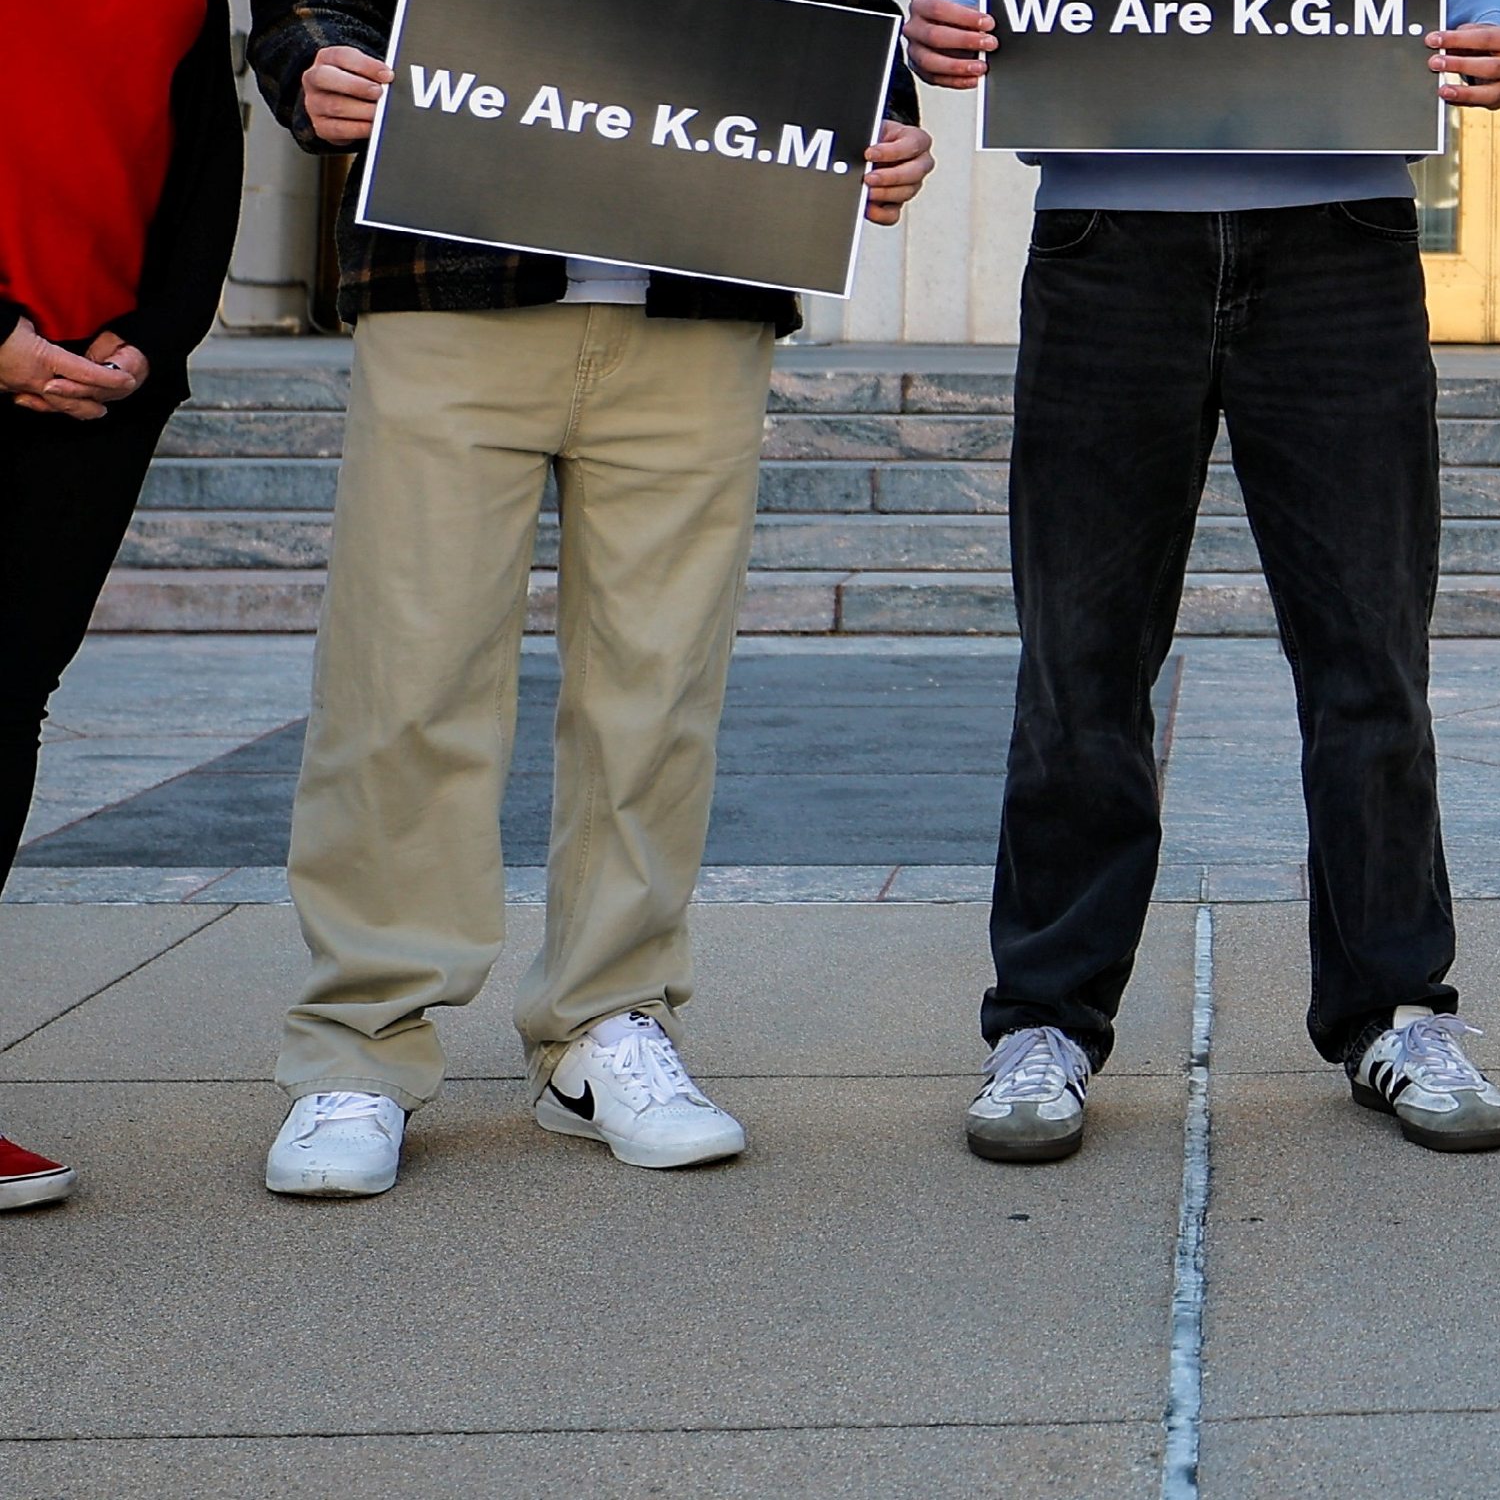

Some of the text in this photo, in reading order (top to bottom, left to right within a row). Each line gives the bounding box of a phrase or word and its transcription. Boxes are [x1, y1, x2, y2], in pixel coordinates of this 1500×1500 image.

[408, 63, 849, 174] We Are K.G.M.
